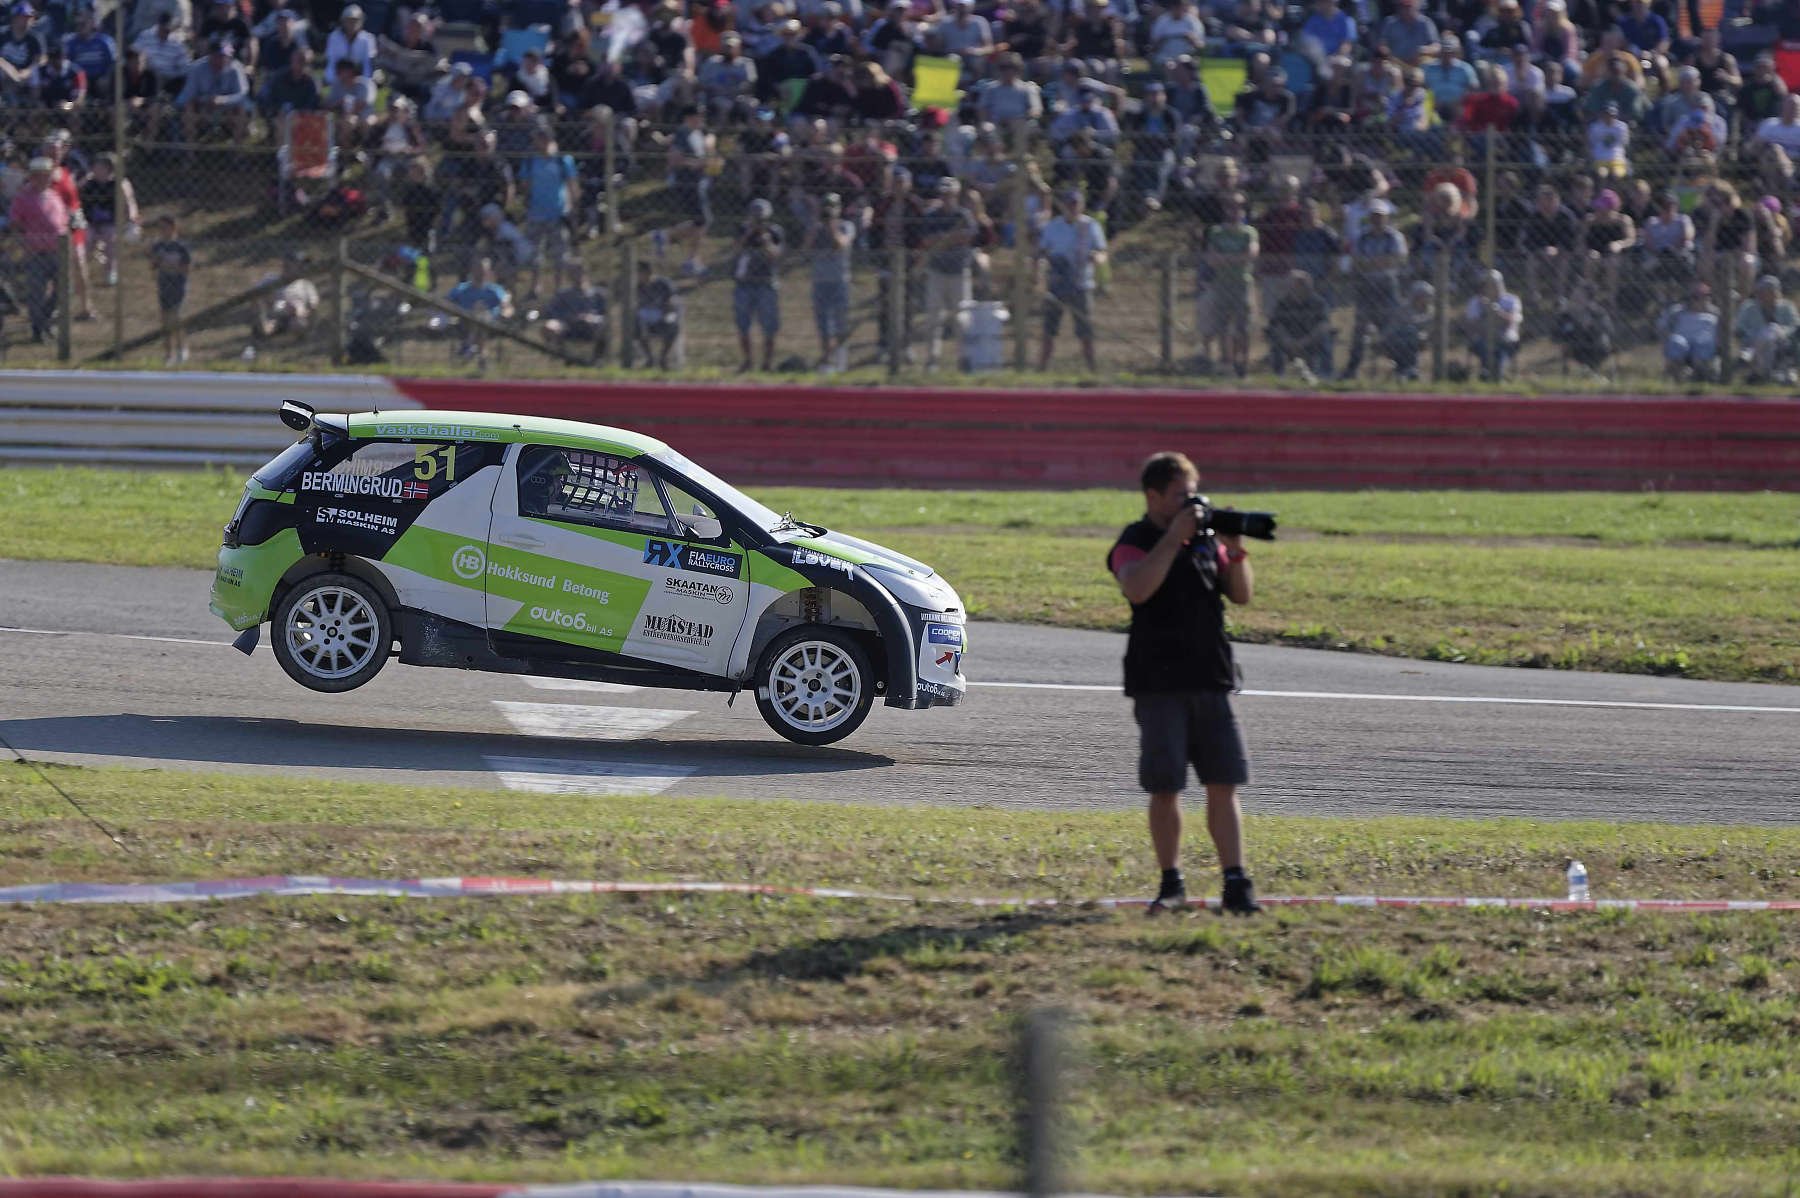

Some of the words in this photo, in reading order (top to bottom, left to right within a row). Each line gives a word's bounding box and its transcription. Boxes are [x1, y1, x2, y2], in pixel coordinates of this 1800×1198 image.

[413, 444, 456, 481] 51
[301, 471, 403, 497] BERMINGRUD
[336, 518, 379, 531] MASKIN
[380, 526, 396, 535] AS
[338, 508, 398, 527] SOLHEIM
[687, 558, 735, 573] RALLYCROSS
[487, 561, 556, 589] Hokksund
[562, 578, 609, 604] Betong
[665, 577, 719, 593] SKAATAN
[675, 588, 706, 598] MASKIN
